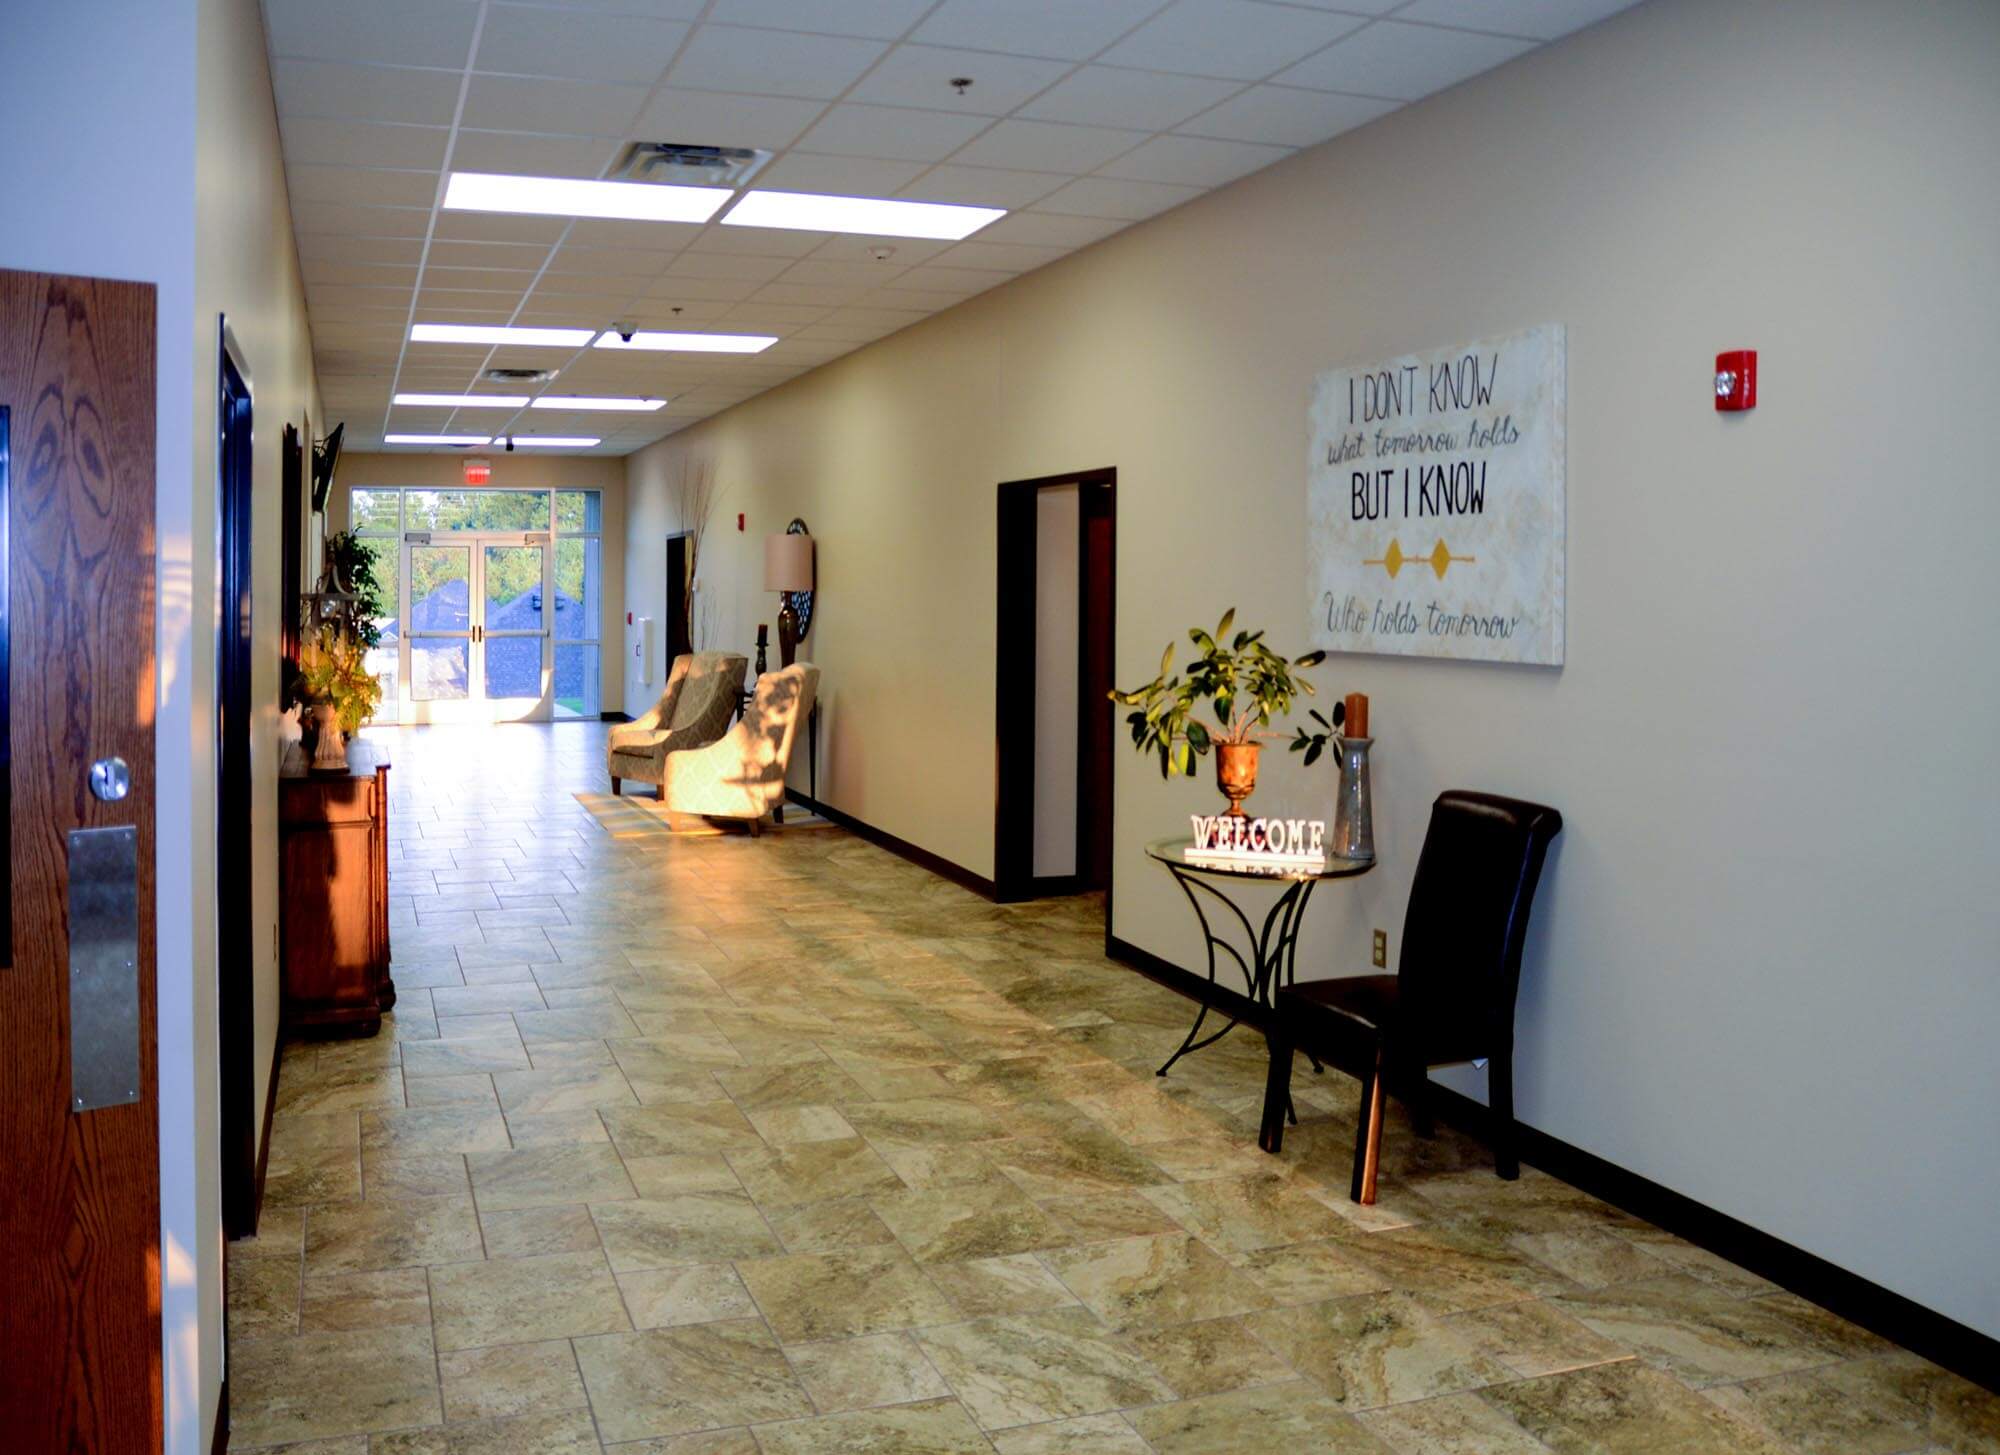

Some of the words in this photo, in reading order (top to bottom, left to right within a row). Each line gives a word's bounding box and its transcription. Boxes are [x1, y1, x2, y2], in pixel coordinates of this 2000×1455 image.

[1349, 377, 1354, 425] I
[1429, 353, 1498, 414] KNOW
[1328, 431, 1365, 465] what
[1375, 428, 1457, 459] tomorrow
[1467, 415, 1521, 448] holds
[1351, 469, 1394, 520] BUT
[1404, 467, 1409, 518] I
[1419, 460, 1487, 517] KNOW
[1323, 591, 1367, 633] Who
[1371, 599, 1420, 635] holds
[1427, 600, 1521, 639] tomorrow
[1190, 814, 1326, 857] WELCOME
